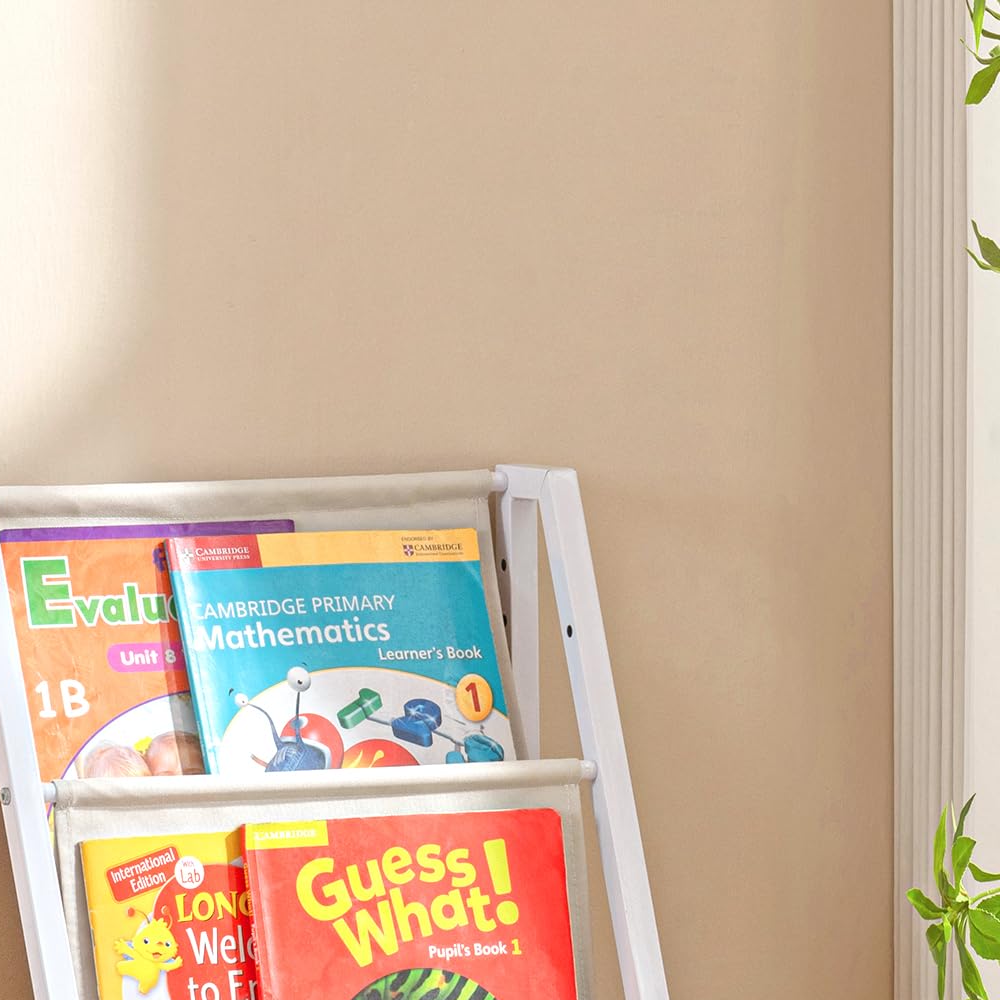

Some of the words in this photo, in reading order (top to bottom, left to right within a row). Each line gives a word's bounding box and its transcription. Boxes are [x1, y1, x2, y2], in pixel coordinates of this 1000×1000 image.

[195, 546, 249, 557] CAMBRIDGE
[414, 543, 463, 551] CAMBRIDGE
[193, 598, 306, 620] CAMBRIDGE
[312, 595, 396, 613] PRIMARY
[194, 616, 391, 651] Mathematics
[120, 649, 158, 666] Unit
[164, 649, 177, 664] 8
[378, 646, 443, 661] Learner's
[447, 645, 482, 660] Book
[35, 679, 90, 718] 1B
[465, 682, 481, 712] 1
[110, 848, 176, 884] International
[180, 869, 200, 884] Lab
[130, 872, 167, 893] Edition
[296, 844, 477, 921] Guess
[428, 944, 471, 961] Pupil's
[474, 942, 507, 956] Book
[511, 939, 522, 955] 1
